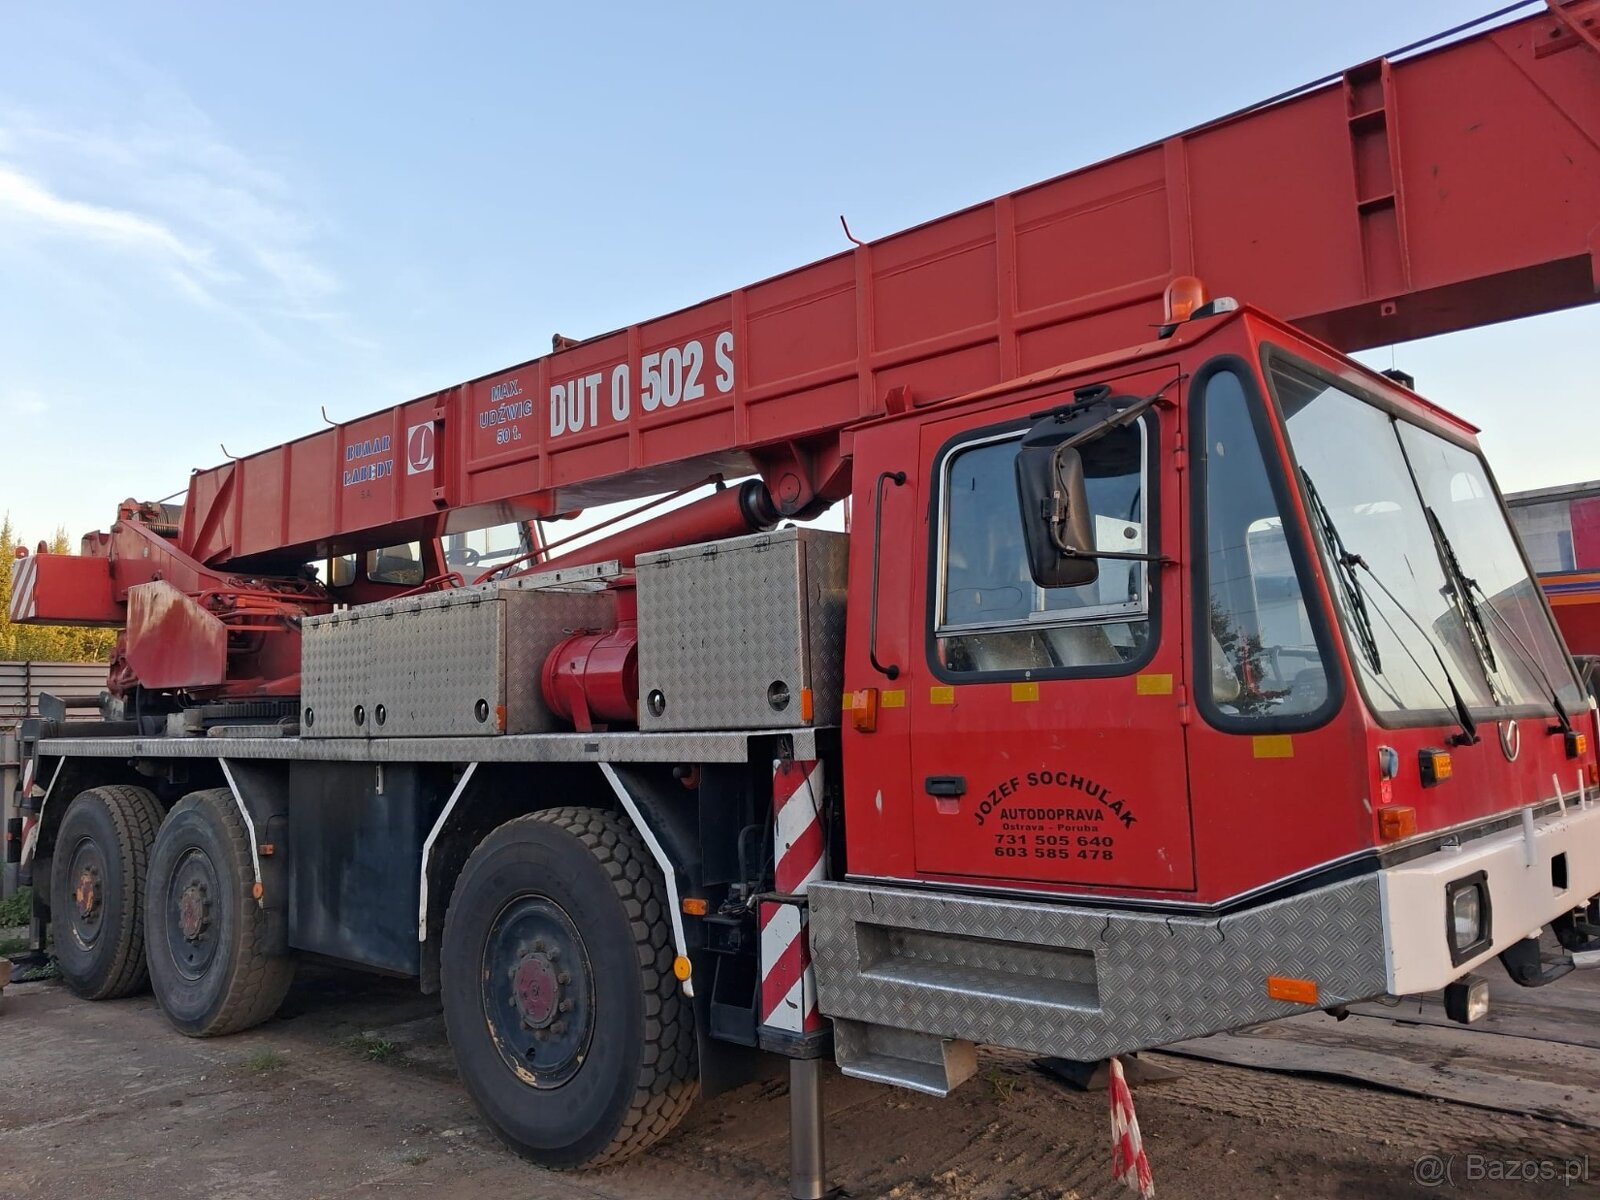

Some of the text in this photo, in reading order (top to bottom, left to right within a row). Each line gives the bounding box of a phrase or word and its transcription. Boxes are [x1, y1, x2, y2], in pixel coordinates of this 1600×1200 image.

[491, 379, 523, 402] MAX.
[550, 372, 602, 437] DUT
[641, 340, 705, 412] 502
[714, 331, 735, 393] S
[479, 399, 533, 429] UDŹWIG
[496, 427, 511, 445] 50
[346, 434, 391, 462] BUMAR
[974, 776, 1020, 826] JOZEF
[999, 808, 1105, 821] AUTODOPRAVA
[1002, 823, 1045, 832] Ostrava
[1057, 823, 1099, 832] Poruba
[994, 834, 1114, 848] 731 505 640
[994, 846, 1114, 861] 603 585 478
